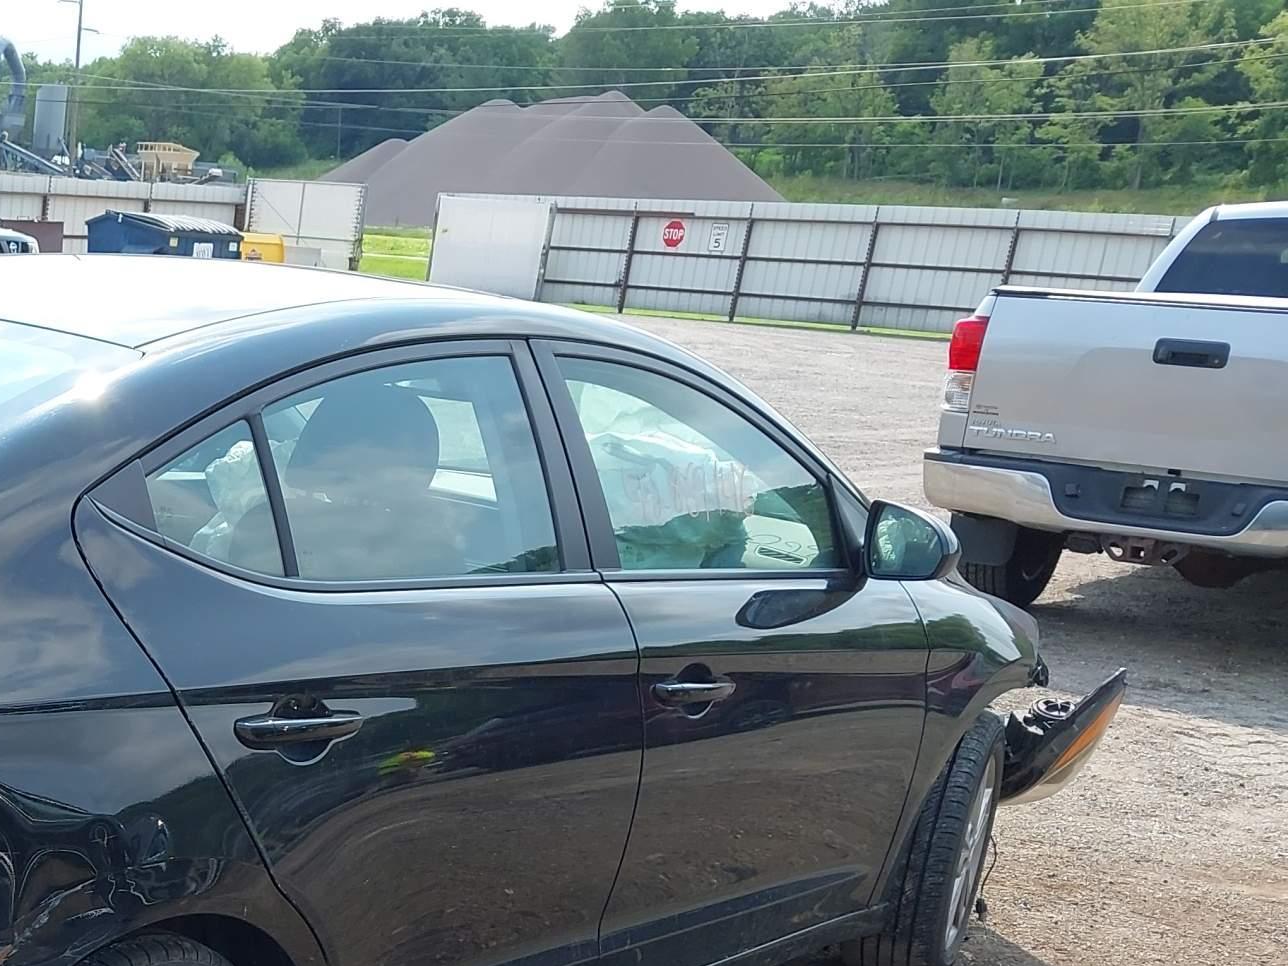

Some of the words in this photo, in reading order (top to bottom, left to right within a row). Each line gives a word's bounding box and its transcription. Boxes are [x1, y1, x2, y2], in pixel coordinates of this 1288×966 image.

[663, 228, 685, 240] STOP
[713, 238, 721, 248] 5
[968, 425, 1056, 444] TUNDRA
